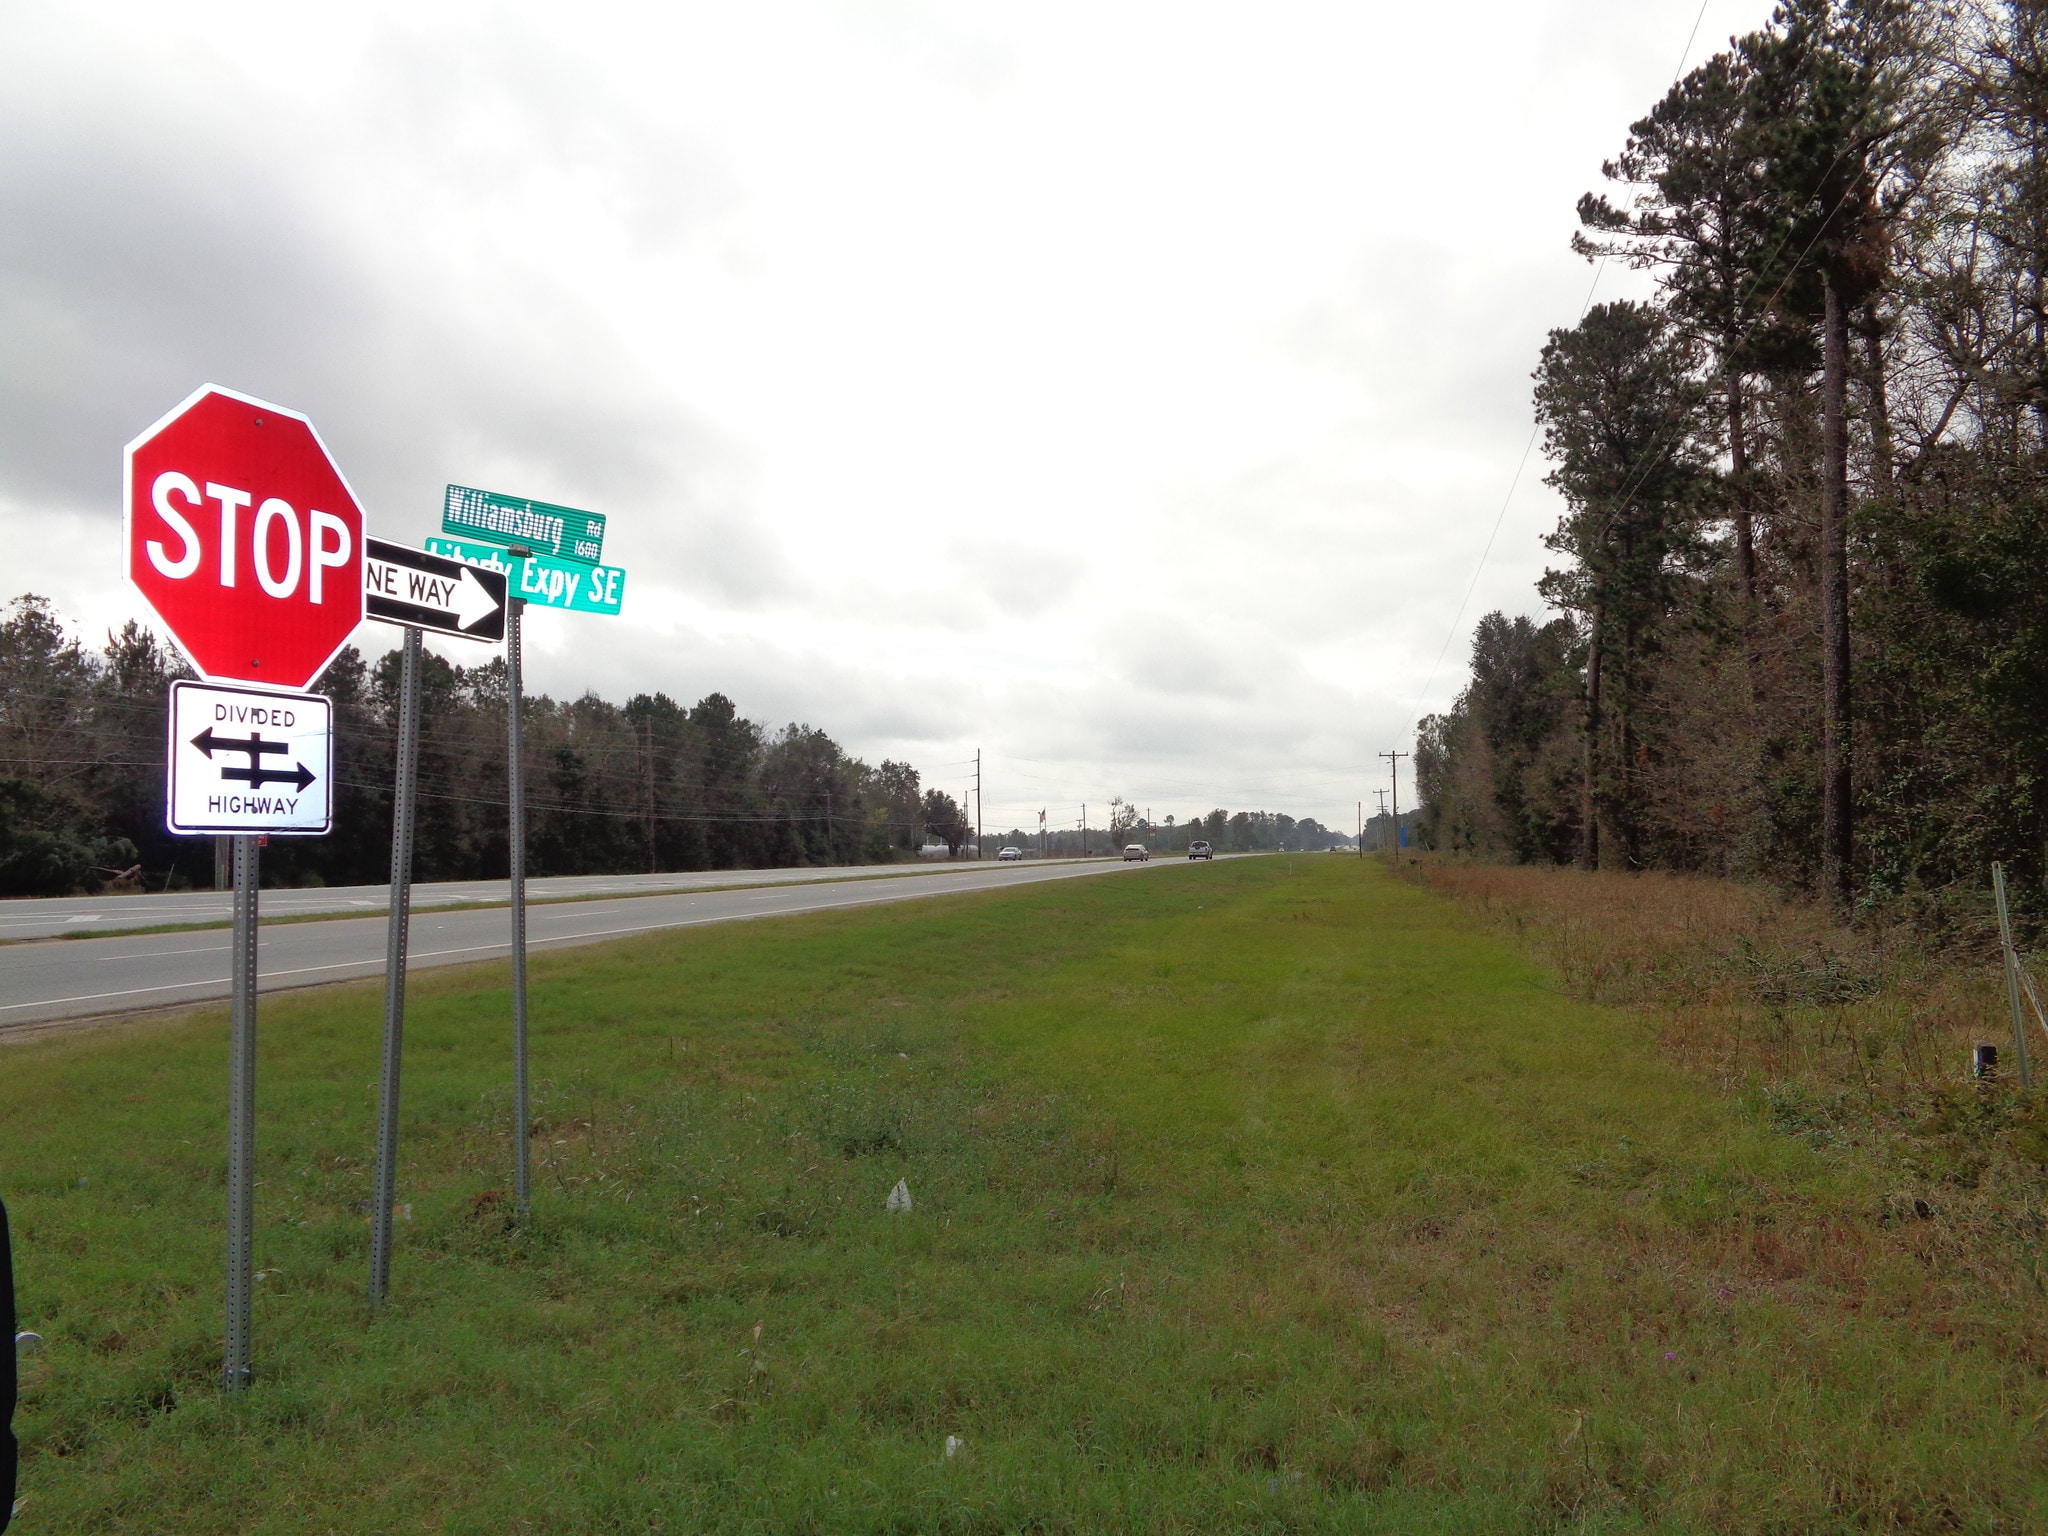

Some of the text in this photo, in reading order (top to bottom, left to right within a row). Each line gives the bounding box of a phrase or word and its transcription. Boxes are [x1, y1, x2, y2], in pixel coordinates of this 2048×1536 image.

[145, 470, 352, 605] STOP
[448, 486, 601, 555] Williamsburg Rd
[574, 539, 598, 559] 1600
[366, 562, 456, 607] NE WAY
[521, 557, 580, 607] Expy
[587, 568, 621, 605] SE
[215, 703, 296, 728] DIVIDED
[208, 795, 299, 816] HIGHWAY
